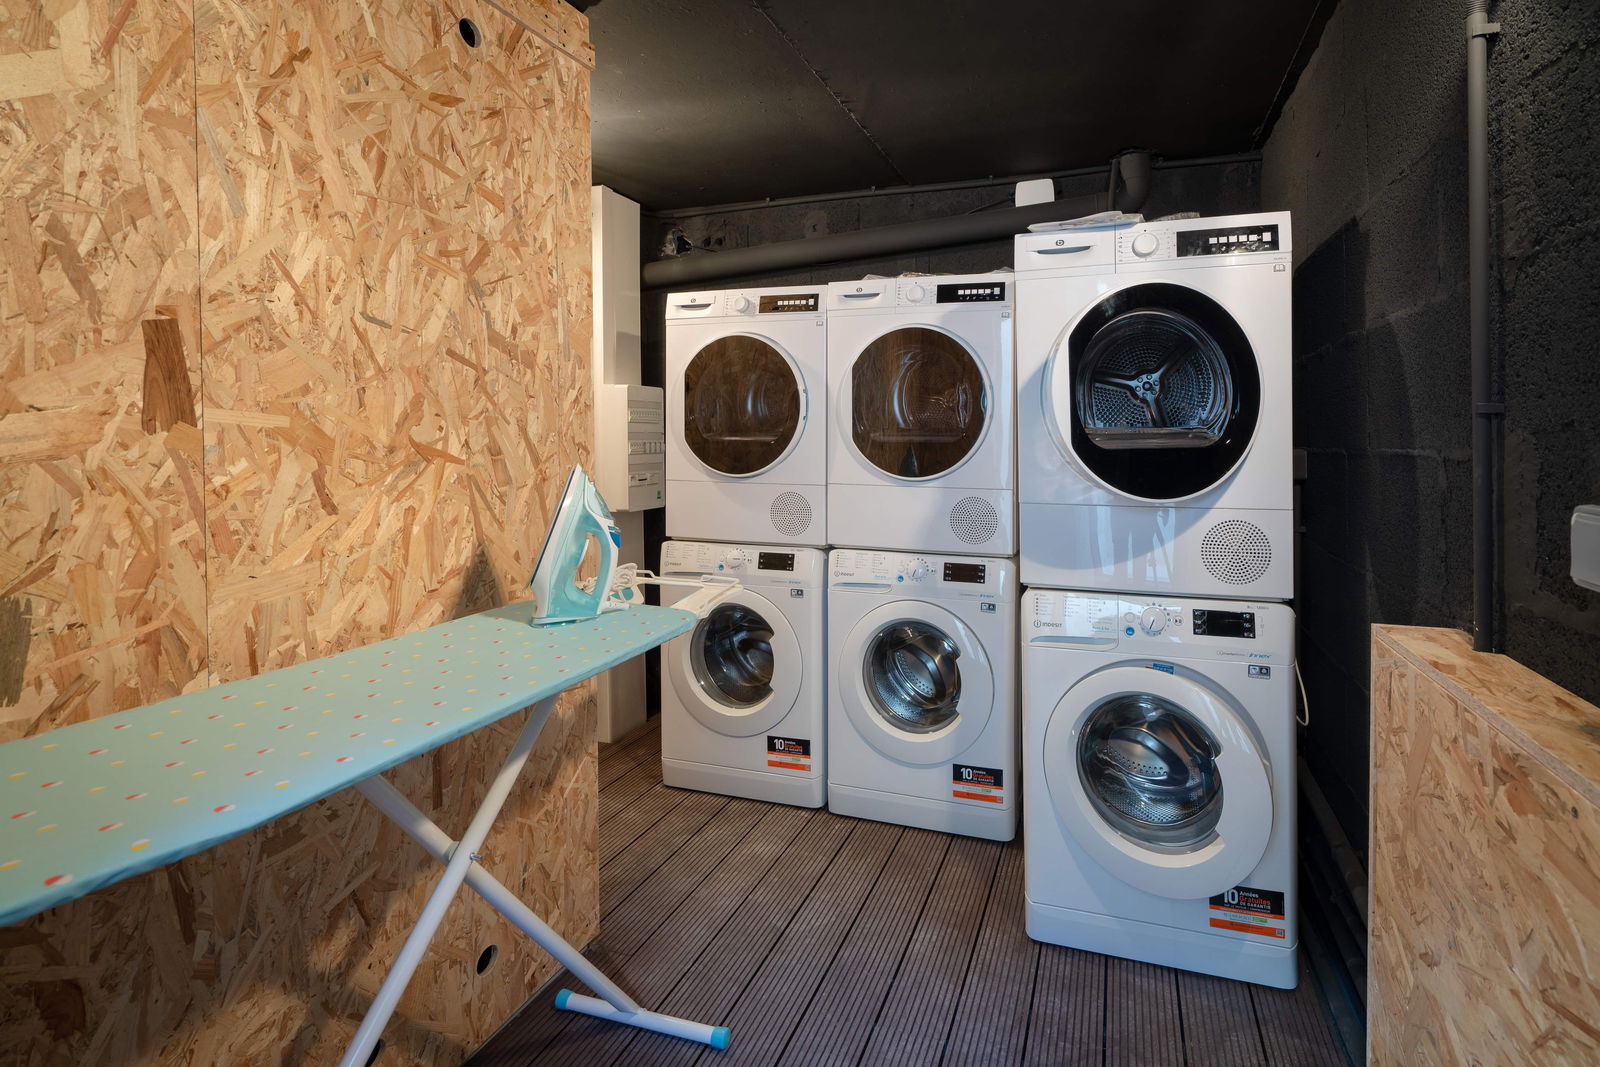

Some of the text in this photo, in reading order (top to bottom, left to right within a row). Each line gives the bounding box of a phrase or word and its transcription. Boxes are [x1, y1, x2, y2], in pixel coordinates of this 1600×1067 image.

[774, 739, 784, 750] 10
[960, 767, 972, 780] 10
[1224, 889, 1239, 905] 10
[1239, 896, 1272, 906] Gratuites
